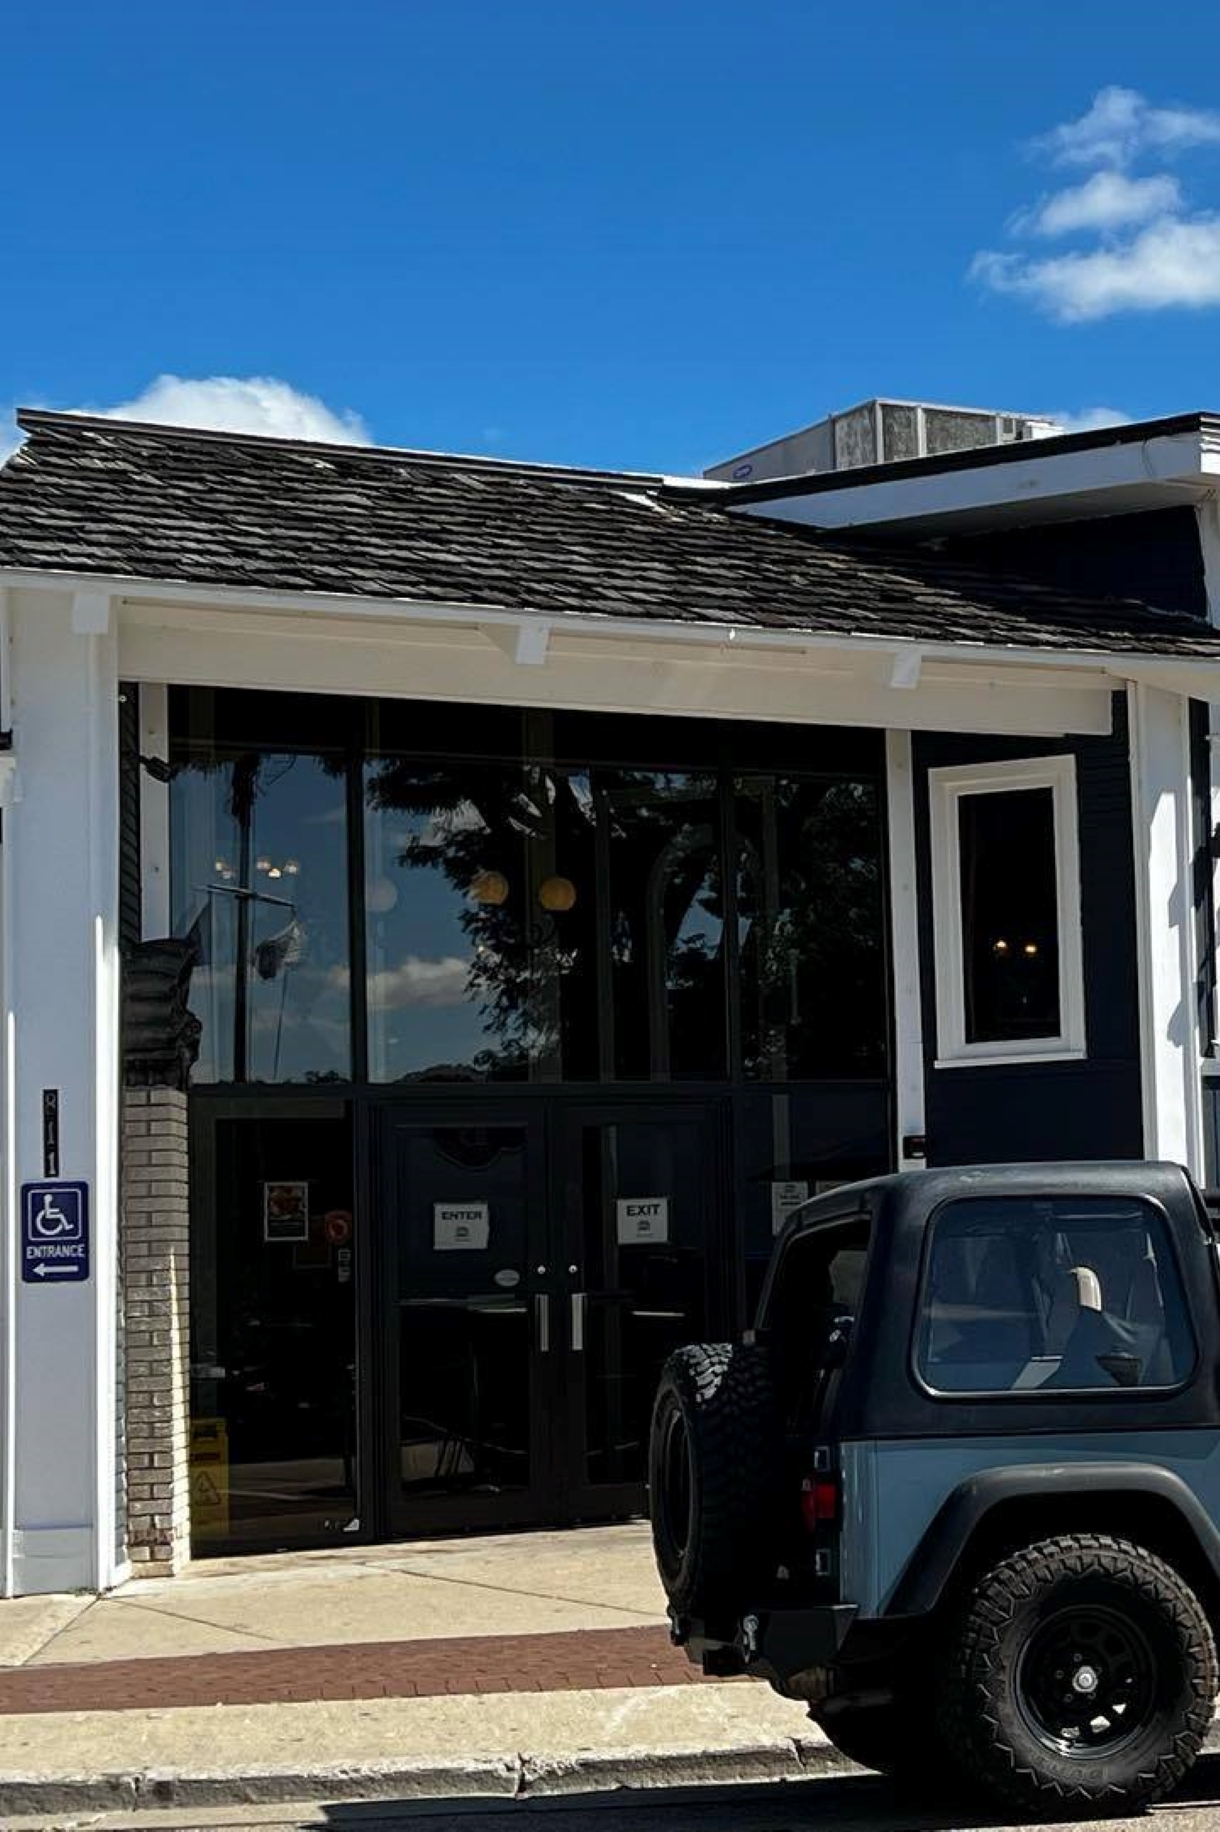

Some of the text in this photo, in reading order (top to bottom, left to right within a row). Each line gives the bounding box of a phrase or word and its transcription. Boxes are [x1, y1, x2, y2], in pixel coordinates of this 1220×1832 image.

[440, 1210, 483, 1222] ENTER
[625, 1203, 662, 1217] EXIT
[26, 1243, 86, 1260] ENTRANCE
